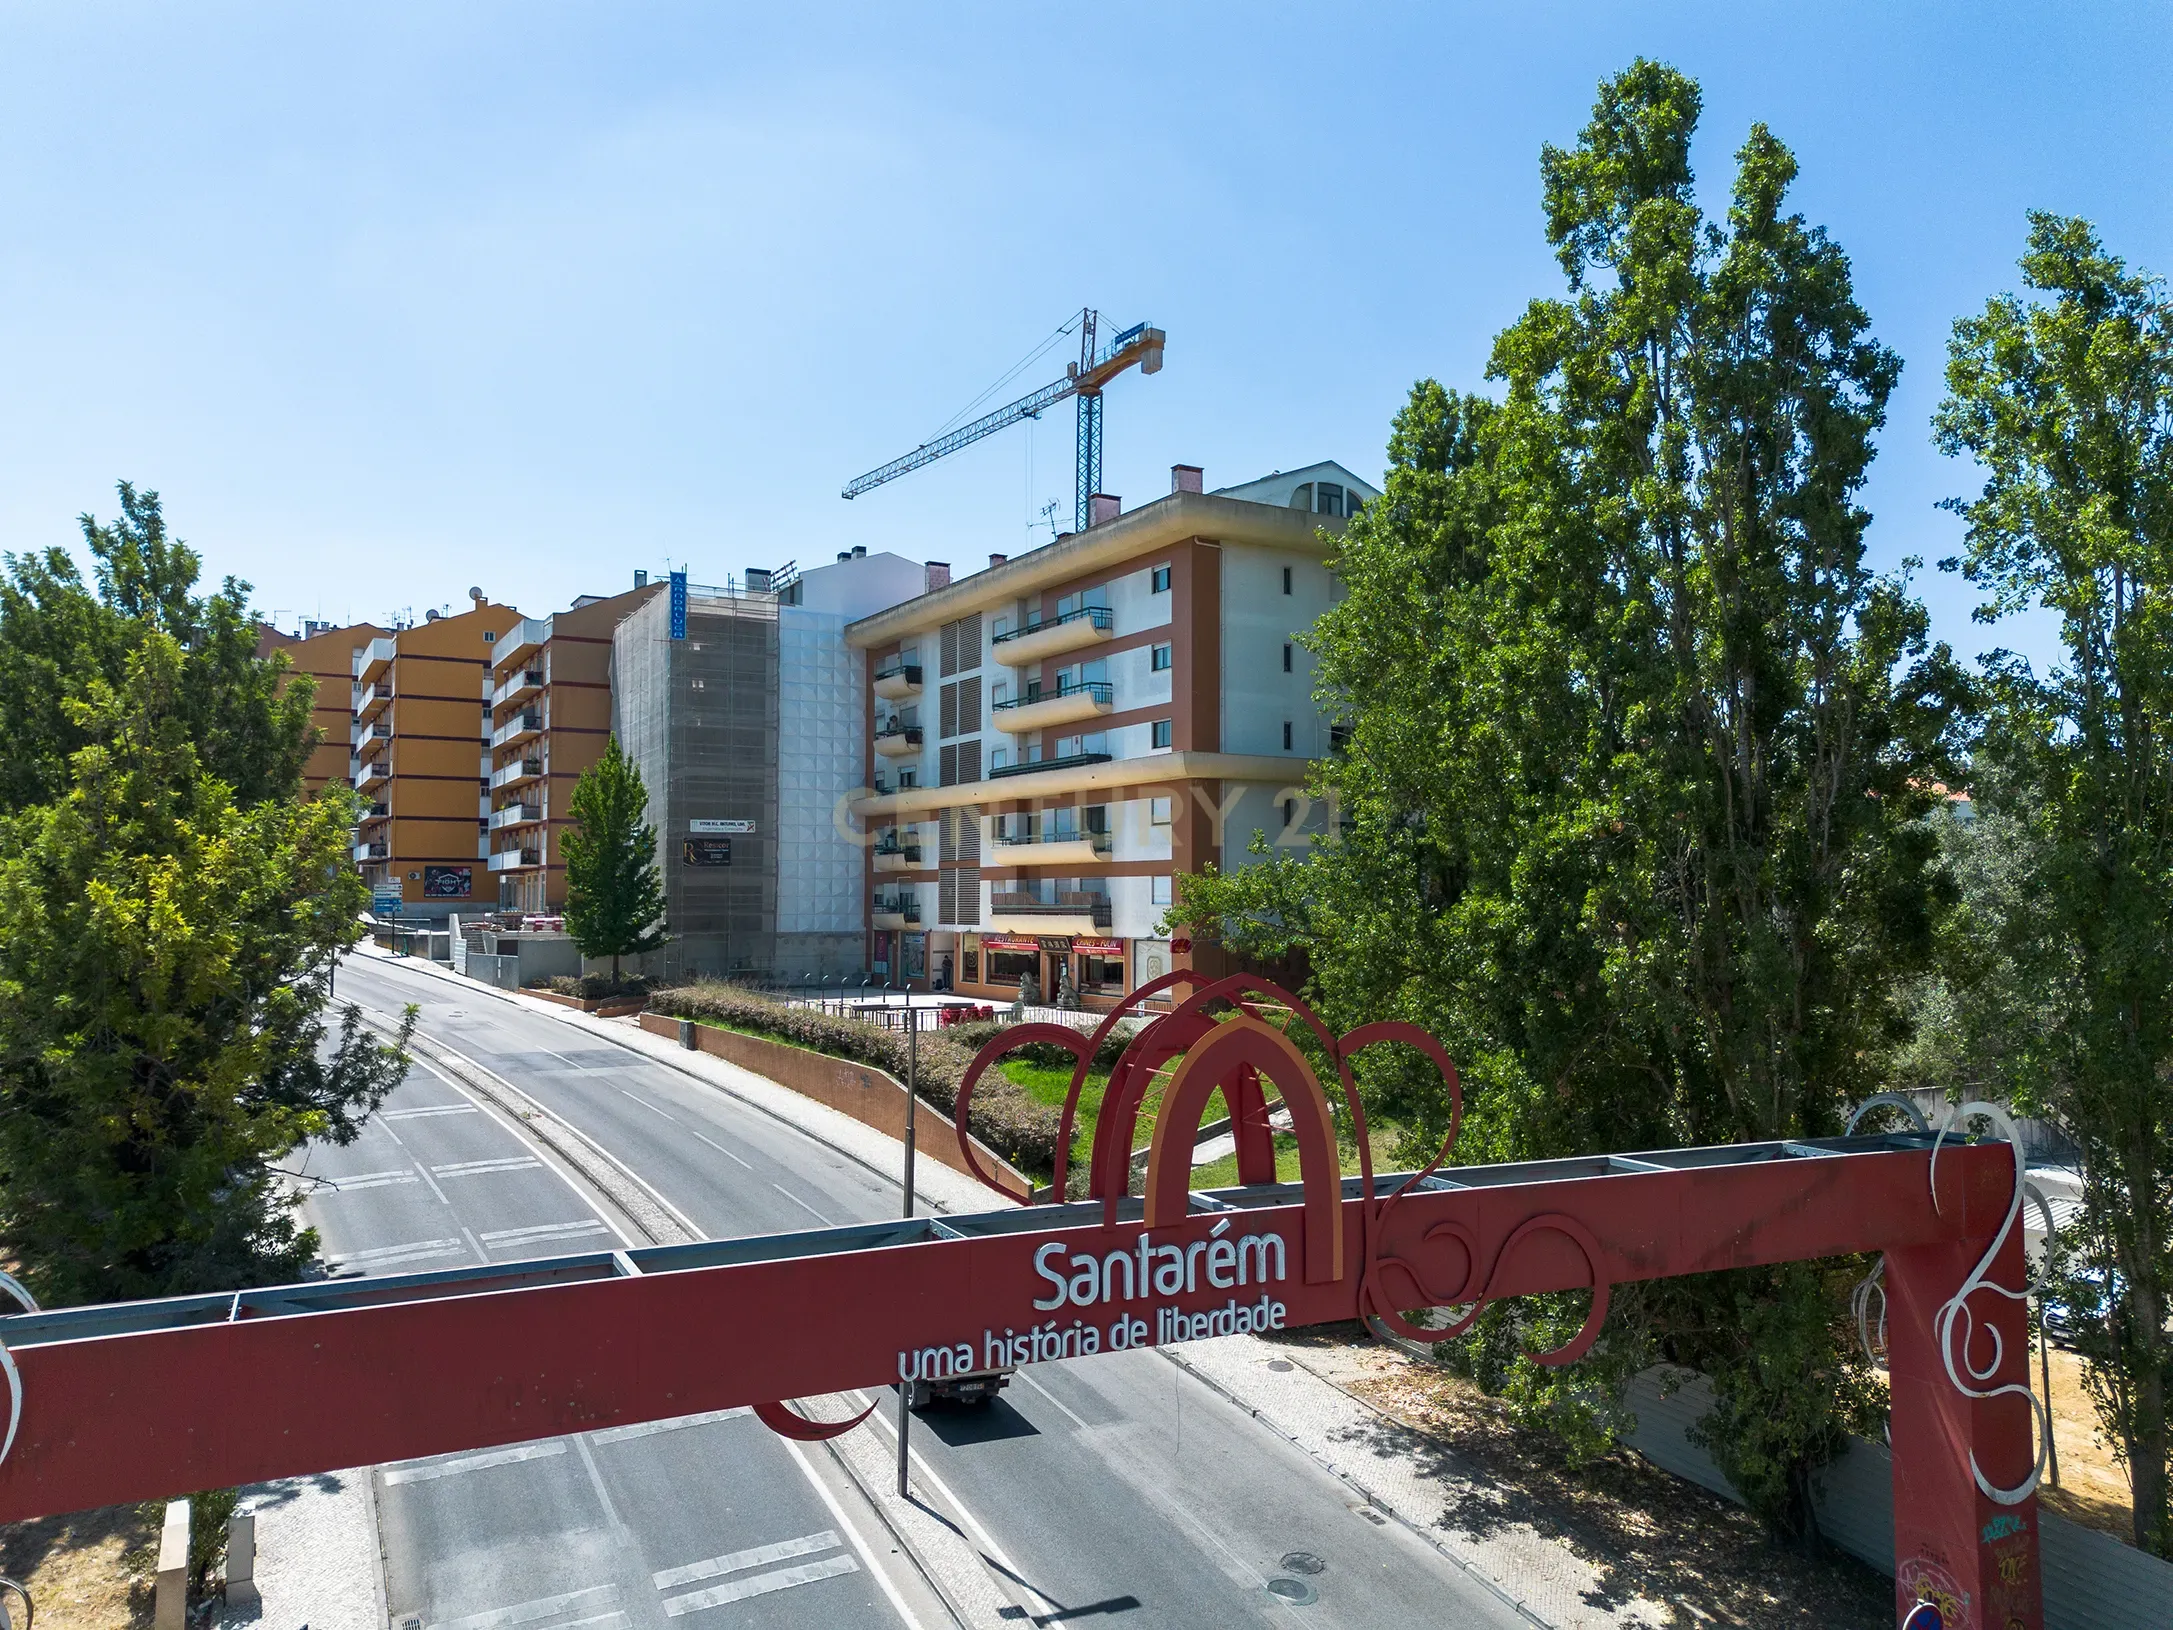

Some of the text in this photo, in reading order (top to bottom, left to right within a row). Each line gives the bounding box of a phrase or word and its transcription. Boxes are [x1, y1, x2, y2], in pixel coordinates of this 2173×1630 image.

[994, 934, 1035, 944] RESTAURANTE
[1032, 1217, 1286, 1312] Santarém
[897, 1293, 1287, 1383] uma história de liberdade
